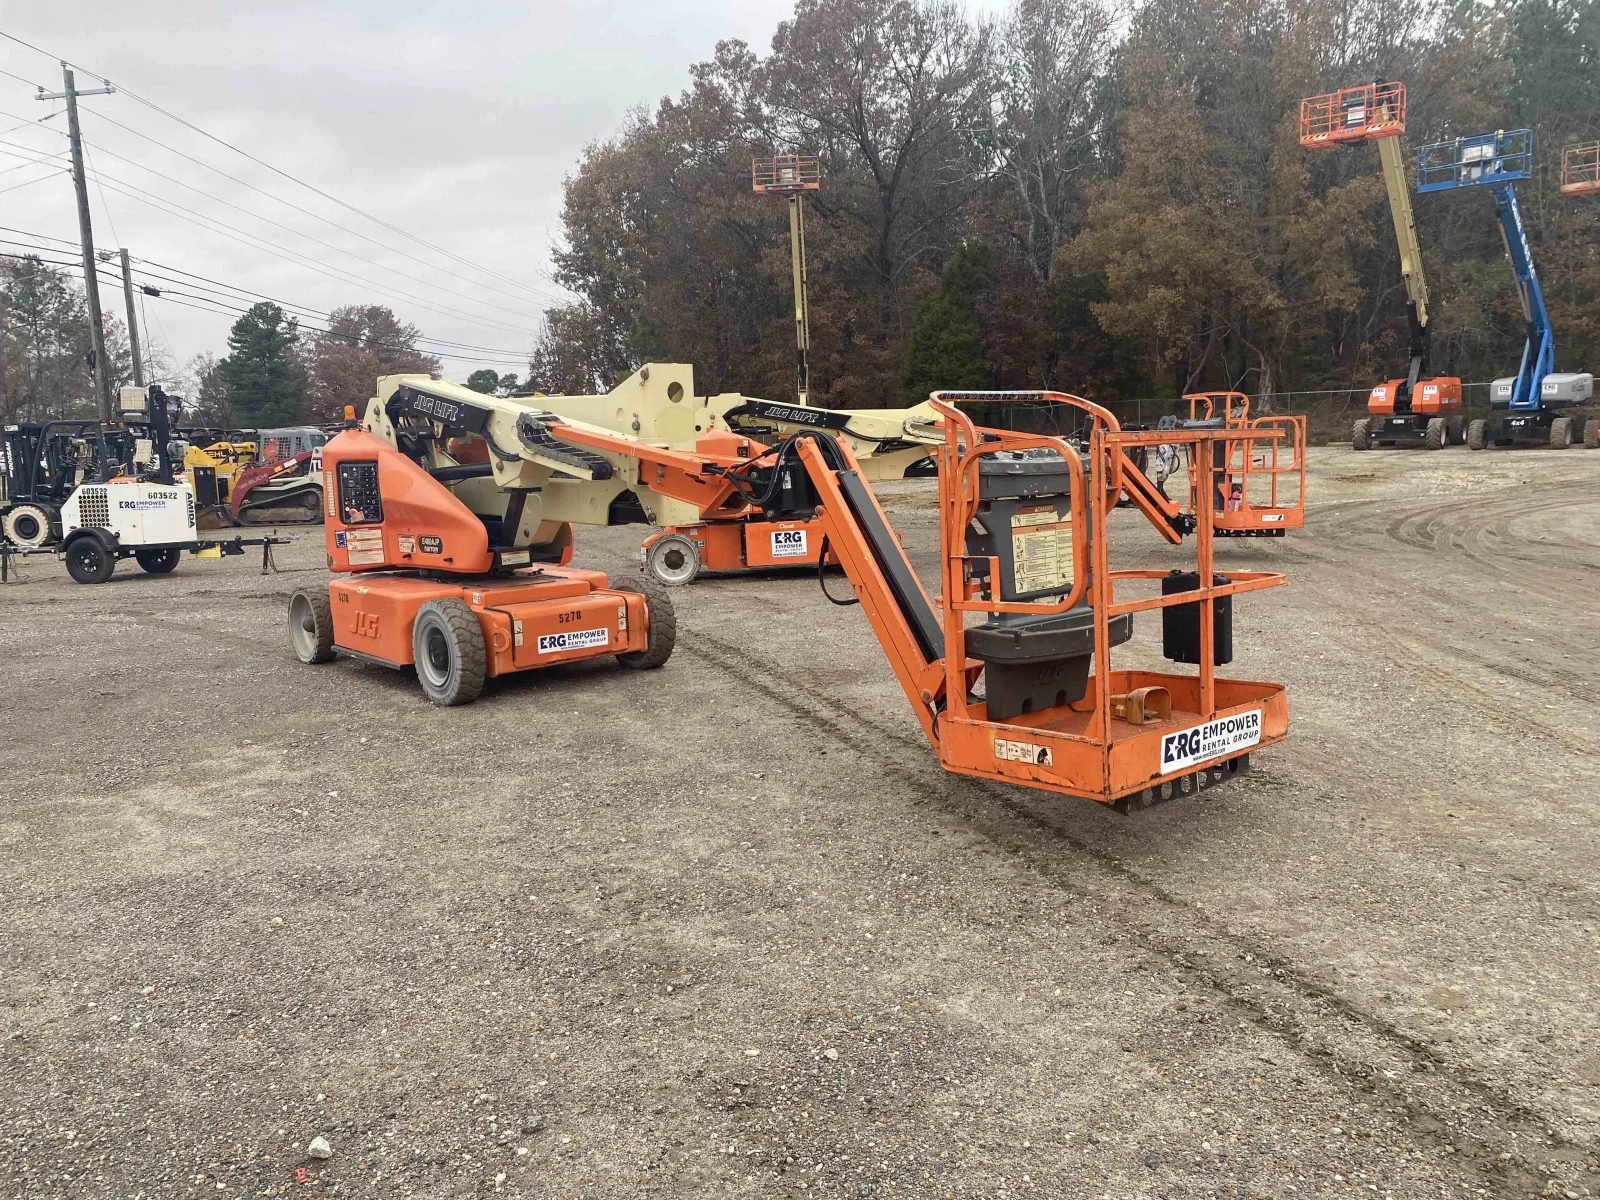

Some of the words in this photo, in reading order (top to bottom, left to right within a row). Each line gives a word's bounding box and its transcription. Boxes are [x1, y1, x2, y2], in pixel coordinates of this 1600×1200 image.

[414, 395, 434, 413] JLG
[434, 401, 458, 421] LIFT
[764, 406, 790, 419] JLG
[789, 410, 819, 423] LIFT
[185, 492, 195, 528] AMIDA
[775, 532, 802, 544] ERG
[559, 611, 582, 623] 5278
[540, 635, 566, 649] ERG
[568, 630, 605, 640] EMPOWER
[1203, 714, 1258, 740] EMPOWER
[1164, 729, 1200, 763] ERG
[1202, 738, 1230, 752] RENTAL
[1233, 730, 1258, 742] GROUP
[1193, 747, 1225, 761] www.rentERG.com
